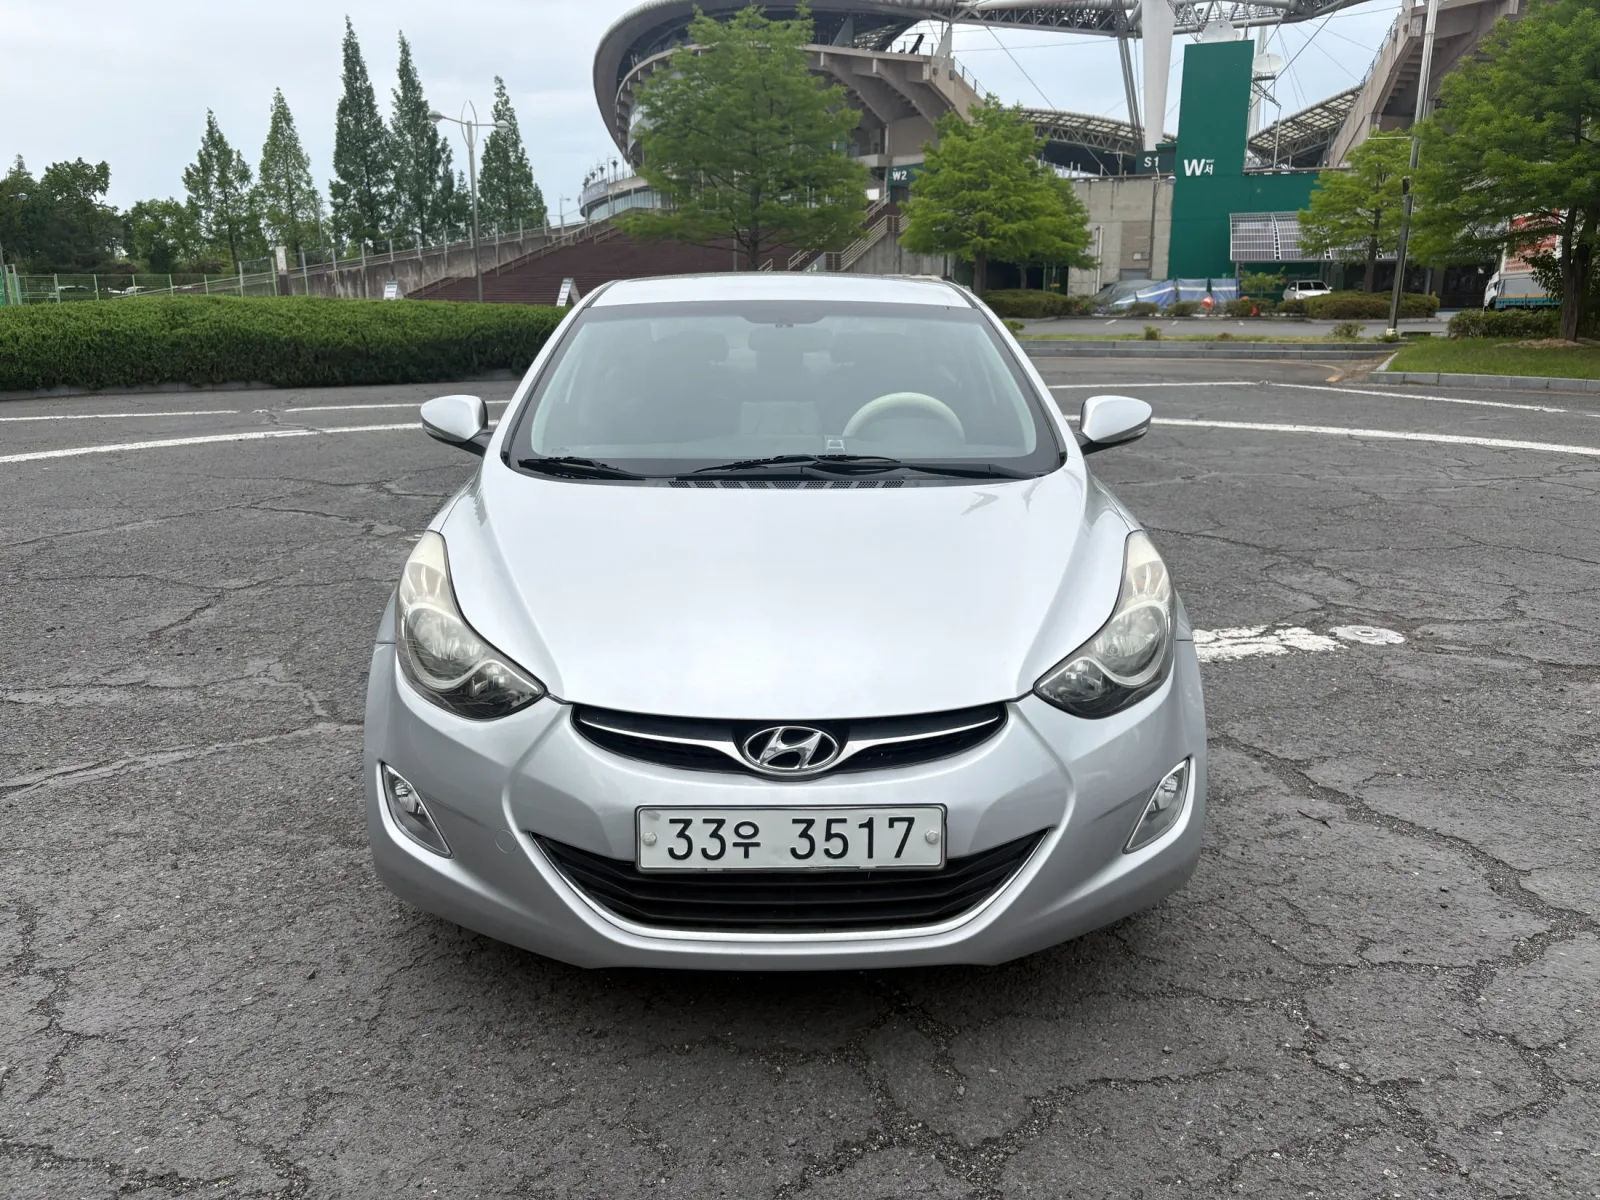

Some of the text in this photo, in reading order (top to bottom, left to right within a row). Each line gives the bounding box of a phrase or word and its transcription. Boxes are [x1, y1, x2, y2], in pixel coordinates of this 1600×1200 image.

[1144, 156, 1159, 168] S1
[892, 170, 907, 181] W2
[667, 816, 916, 860] 33우 3517
